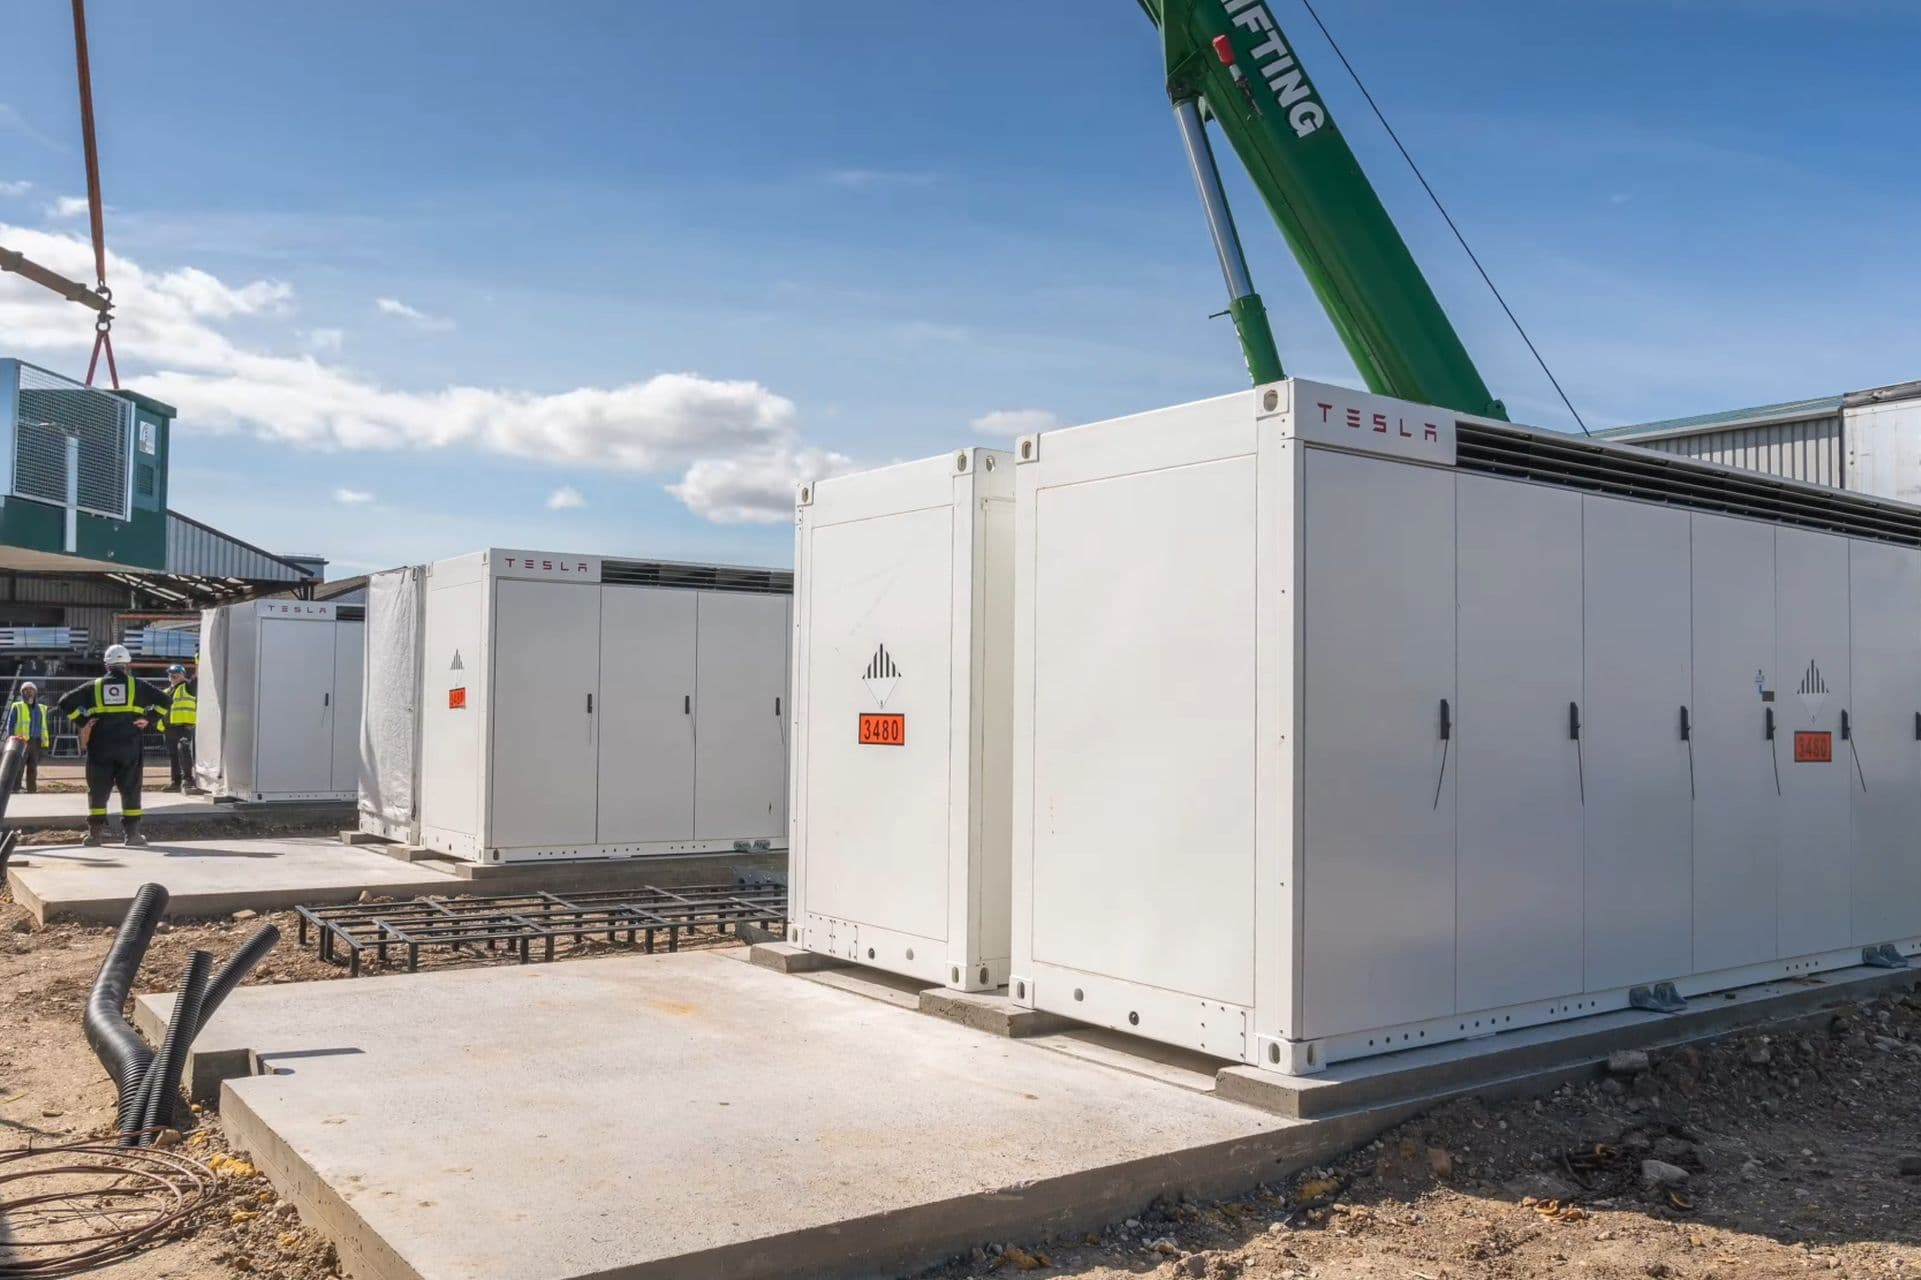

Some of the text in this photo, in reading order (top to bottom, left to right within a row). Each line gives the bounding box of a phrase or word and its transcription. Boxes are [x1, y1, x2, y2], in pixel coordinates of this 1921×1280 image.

[1221, 0, 1325, 138] IFTING
[1317, 402, 1437, 443] TESLA
[505, 558, 588, 573] TESLA
[267, 604, 327, 614] TESLA
[863, 719, 899, 741] 3480
